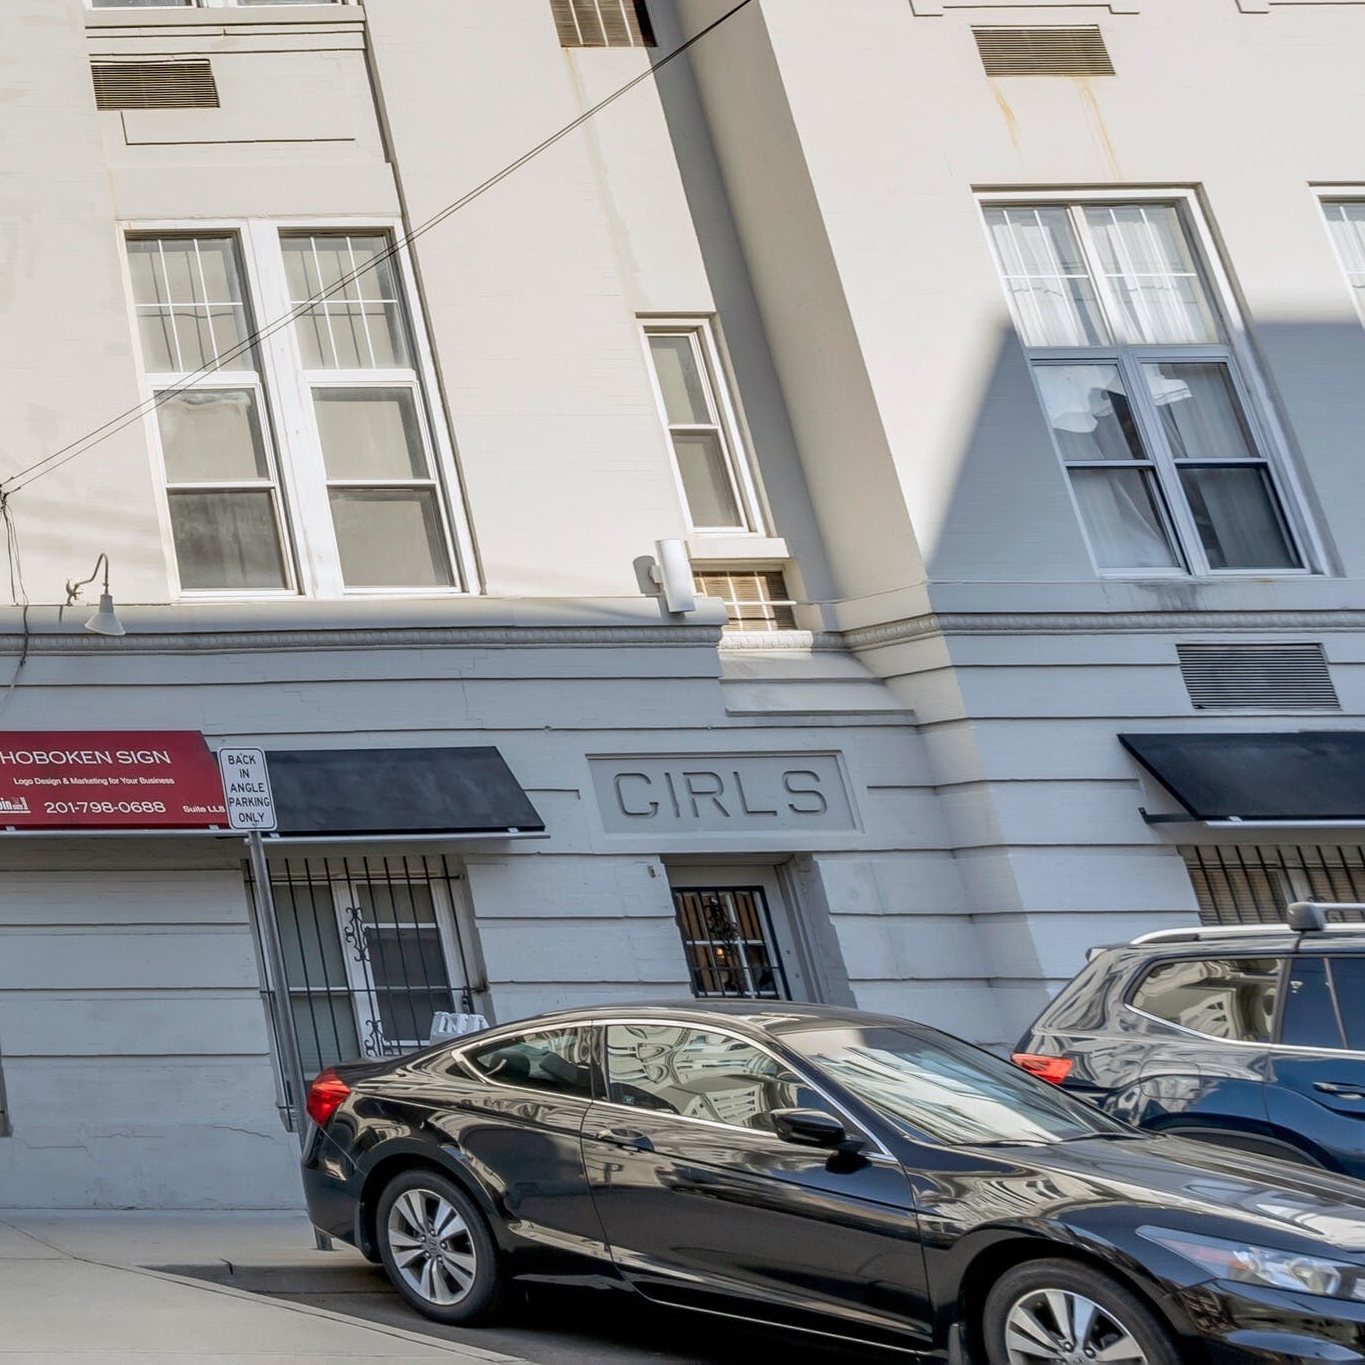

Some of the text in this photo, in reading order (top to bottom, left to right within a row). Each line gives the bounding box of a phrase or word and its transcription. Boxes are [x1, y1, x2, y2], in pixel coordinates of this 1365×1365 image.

[118, 751, 172, 764] SIGN
[228, 755, 256, 765] BACK
[239, 768, 250, 779] IN
[13, 777, 34, 787] Logo
[34, 777, 62, 786] Design
[69, 777, 108, 786] Marketing
[119, 777, 138, 785] Your
[230, 782, 265, 793] ANGLE
[614, 770, 828, 819] GIRLS
[229, 797, 270, 807] PARKING
[44, 801, 167, 814] 201-798-0688
[182, 805, 207, 813] Suite
[238, 812, 264, 822] ONLY
